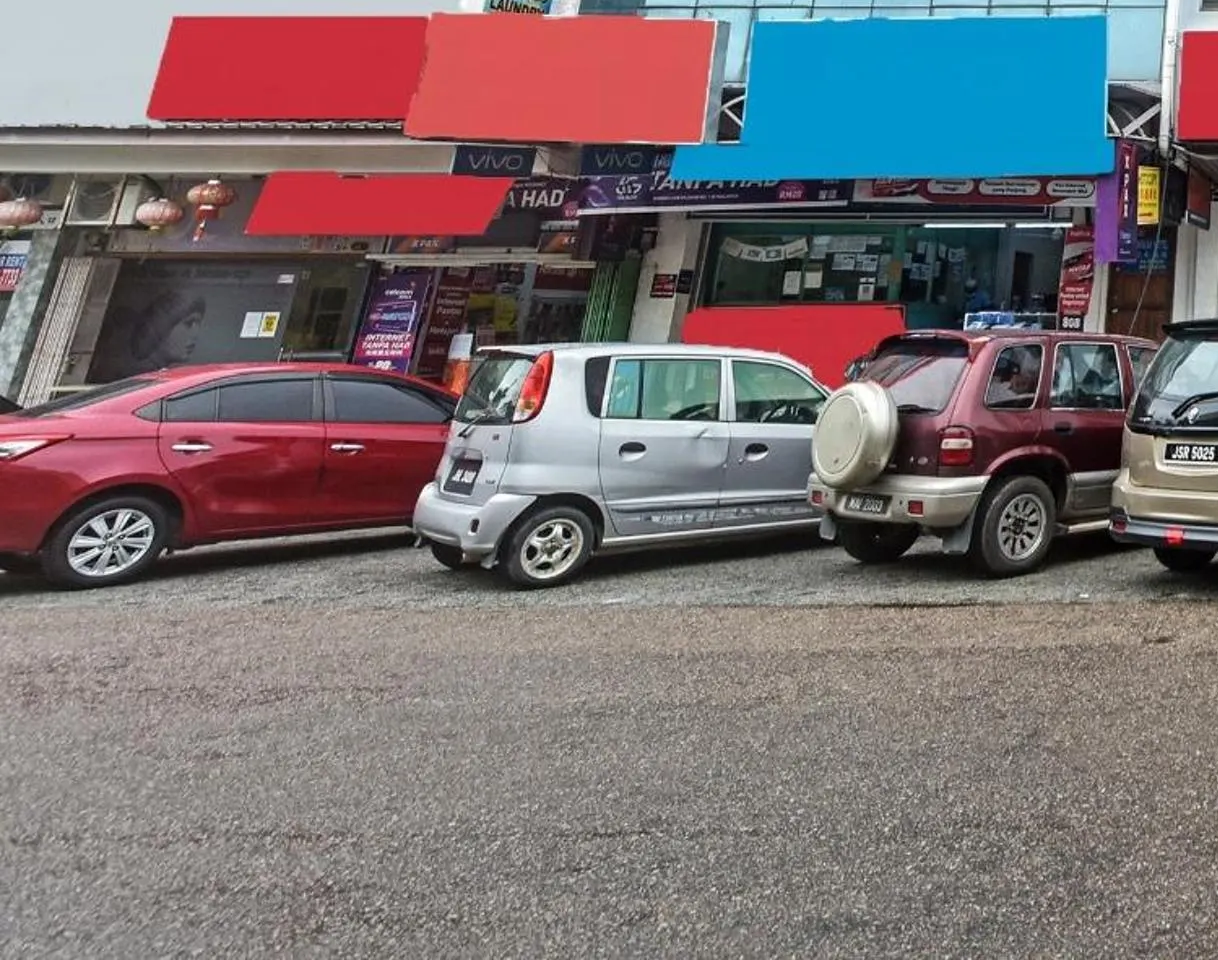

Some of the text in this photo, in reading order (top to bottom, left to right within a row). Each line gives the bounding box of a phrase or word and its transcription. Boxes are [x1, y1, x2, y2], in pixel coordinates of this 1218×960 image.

[365, 334, 412, 342] INTERNET
[1171, 446, 1216, 461] JSR 5025
